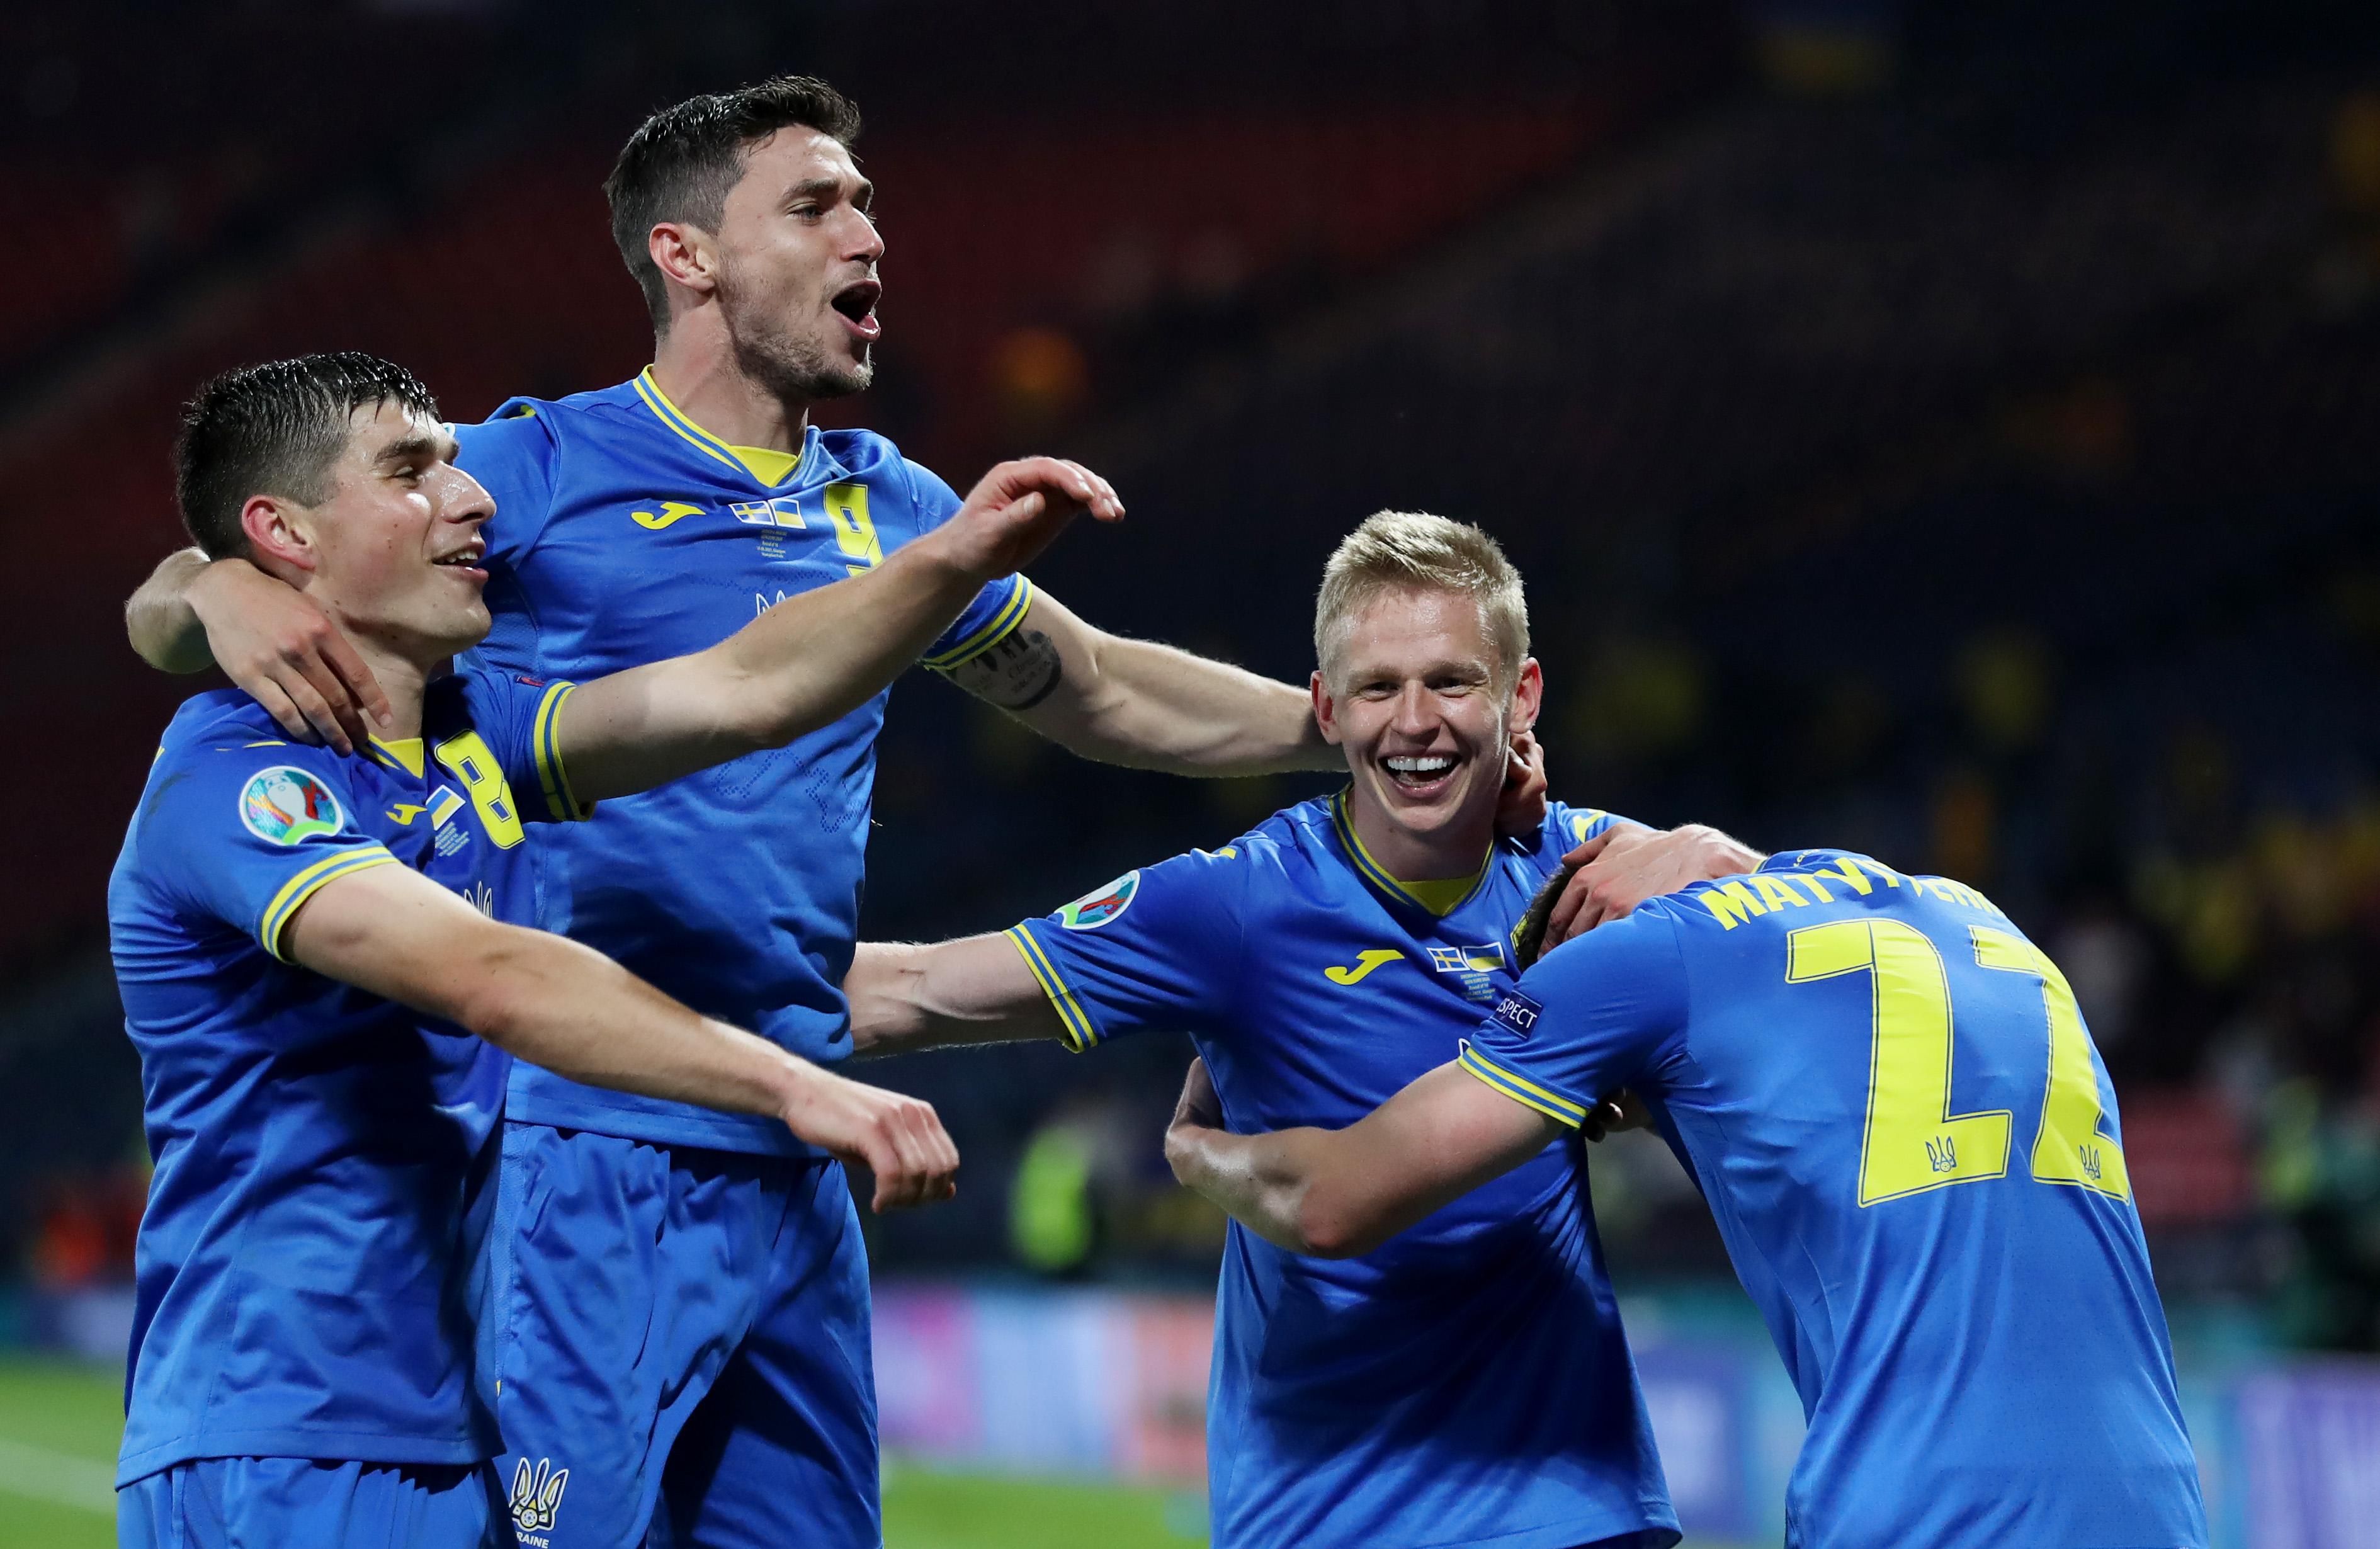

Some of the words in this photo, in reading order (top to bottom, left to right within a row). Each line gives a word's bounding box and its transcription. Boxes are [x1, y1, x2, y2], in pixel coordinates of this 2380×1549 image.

[824, 482, 886, 577] 9
[434, 729, 526, 849] 8
[1496, 997, 1538, 1028] SPECT
[1784, 917, 2130, 1208] 22
[516, 1531, 550, 1549] RAINE
